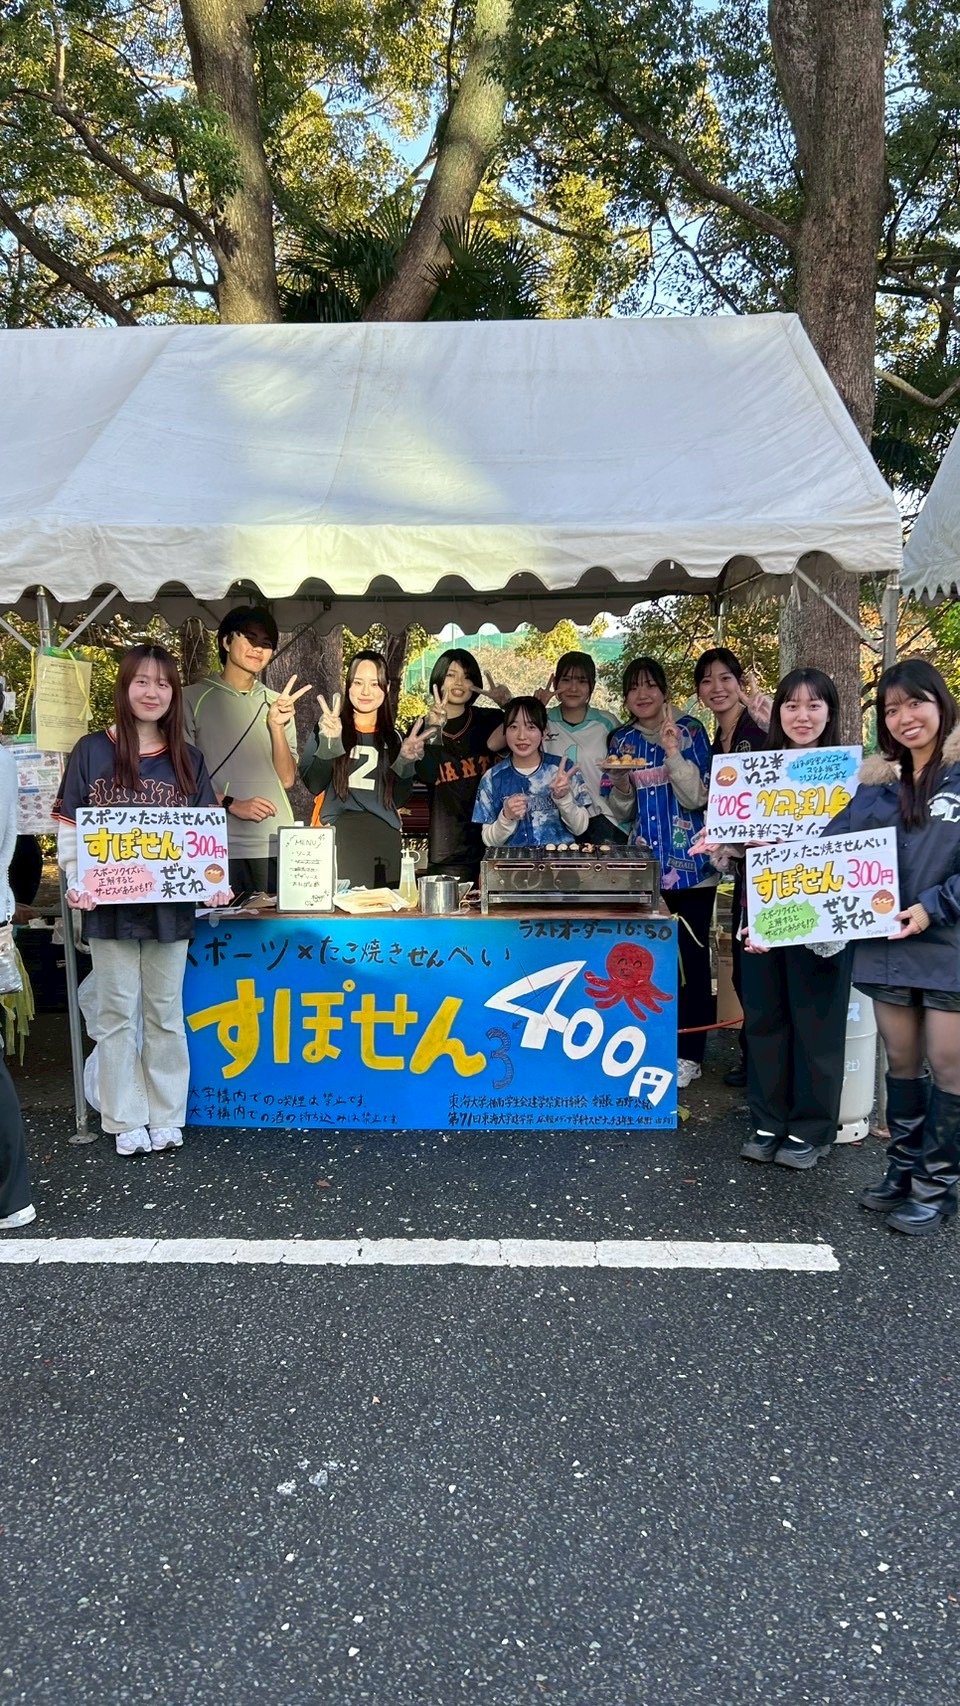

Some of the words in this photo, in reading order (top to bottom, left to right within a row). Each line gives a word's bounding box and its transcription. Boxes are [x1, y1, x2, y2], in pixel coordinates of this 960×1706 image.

[348, 745, 379, 791] 2
[742, 752, 784, 771] 来てね
[744, 770, 780, 788] ぜひ
[757, 785, 852, 821] すぽせん
[81, 808, 226, 826] スポーツ×たこ焼きせんべい
[83, 827, 184, 864] すぽせん
[185, 831, 227, 859] 300円
[752, 838, 887, 868] スポーツ×たこ焼きせんべい
[93, 865, 145, 878] スポーツクイズに
[98, 876, 134, 887] 正解すると
[160, 862, 196, 880] ぜひ
[752, 860, 844, 904] すぽせん
[847, 858, 894, 888] 300円
[160, 878, 207, 899] 来てね
[761, 904, 803, 922] スポーツクイズに
[823, 895, 860, 916] ぜひ
[767, 914, 800, 930] 正解すると
[831, 908, 876, 935] 来てね
[186, 978, 487, 1080] すぽせん
[484, 960, 674, 1107] 400円
